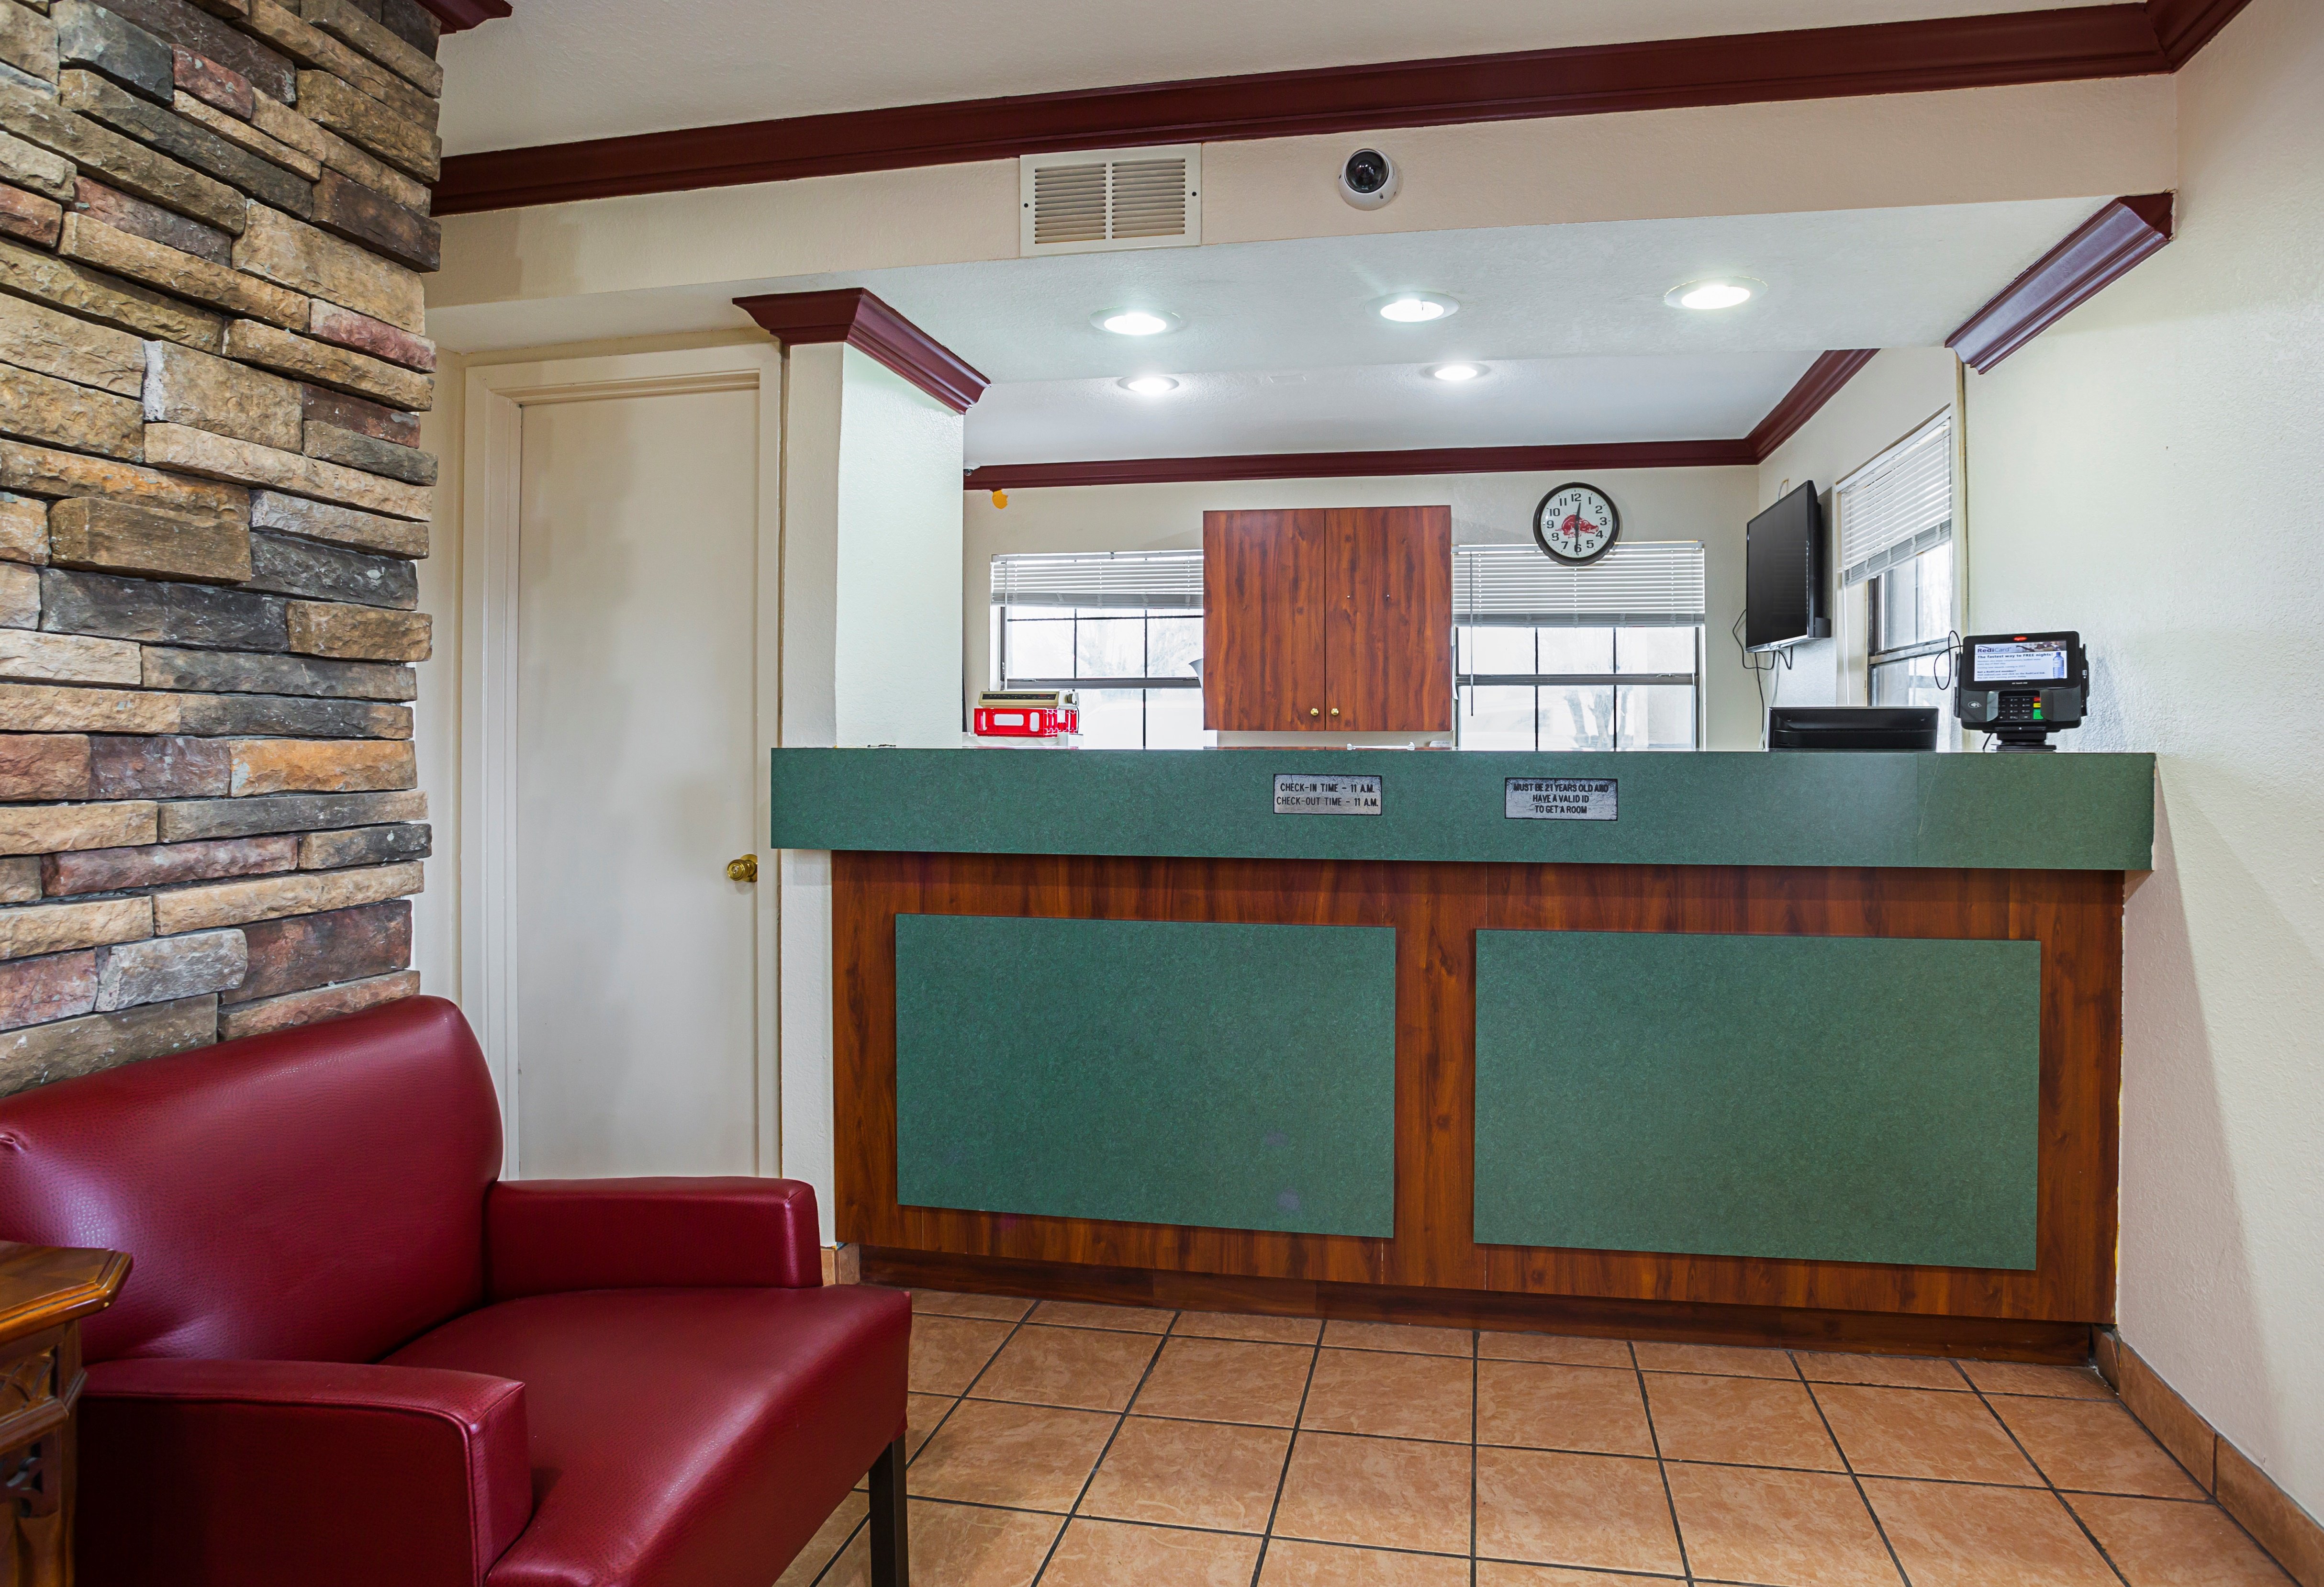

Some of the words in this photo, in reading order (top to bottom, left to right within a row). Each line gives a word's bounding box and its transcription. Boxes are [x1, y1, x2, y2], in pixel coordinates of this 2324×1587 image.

[1571, 493, 1581, 502] 12
[1559, 498, 1567, 506] 11
[1550, 508, 1560, 516] 10
[1595, 505, 1603, 514] 2
[1547, 520, 1554, 528] 9
[1599, 517, 1607, 525] 3
[1552, 533, 1559, 541] 8
[1596, 530, 1603, 538] 4
[1561, 541, 1568, 549] 7
[1574, 544, 1582, 552] 6
[1587, 540, 1594, 548] 5
[1280, 783, 1317, 792] CHECK-IN
[1320, 783, 1339, 793] TIME
[1351, 784, 1357, 793] 11
[1360, 784, 1374, 793] A.M.
[1513, 783, 1533, 792] MUST
[1545, 784, 1553, 792] 21
[1554, 784, 1577, 792] YEARS
[1578, 784, 1593, 793] OLD
[1594, 784, 1609, 793] AND
[1276, 796, 1320, 805] CHECK-OUT
[1324, 797, 1342, 806] TIME
[1354, 798, 1360, 806] 11
[1364, 798, 1378, 806] A.M.
[1533, 794, 1551, 803] HAVE
[1582, 795, 1589, 803] ID
